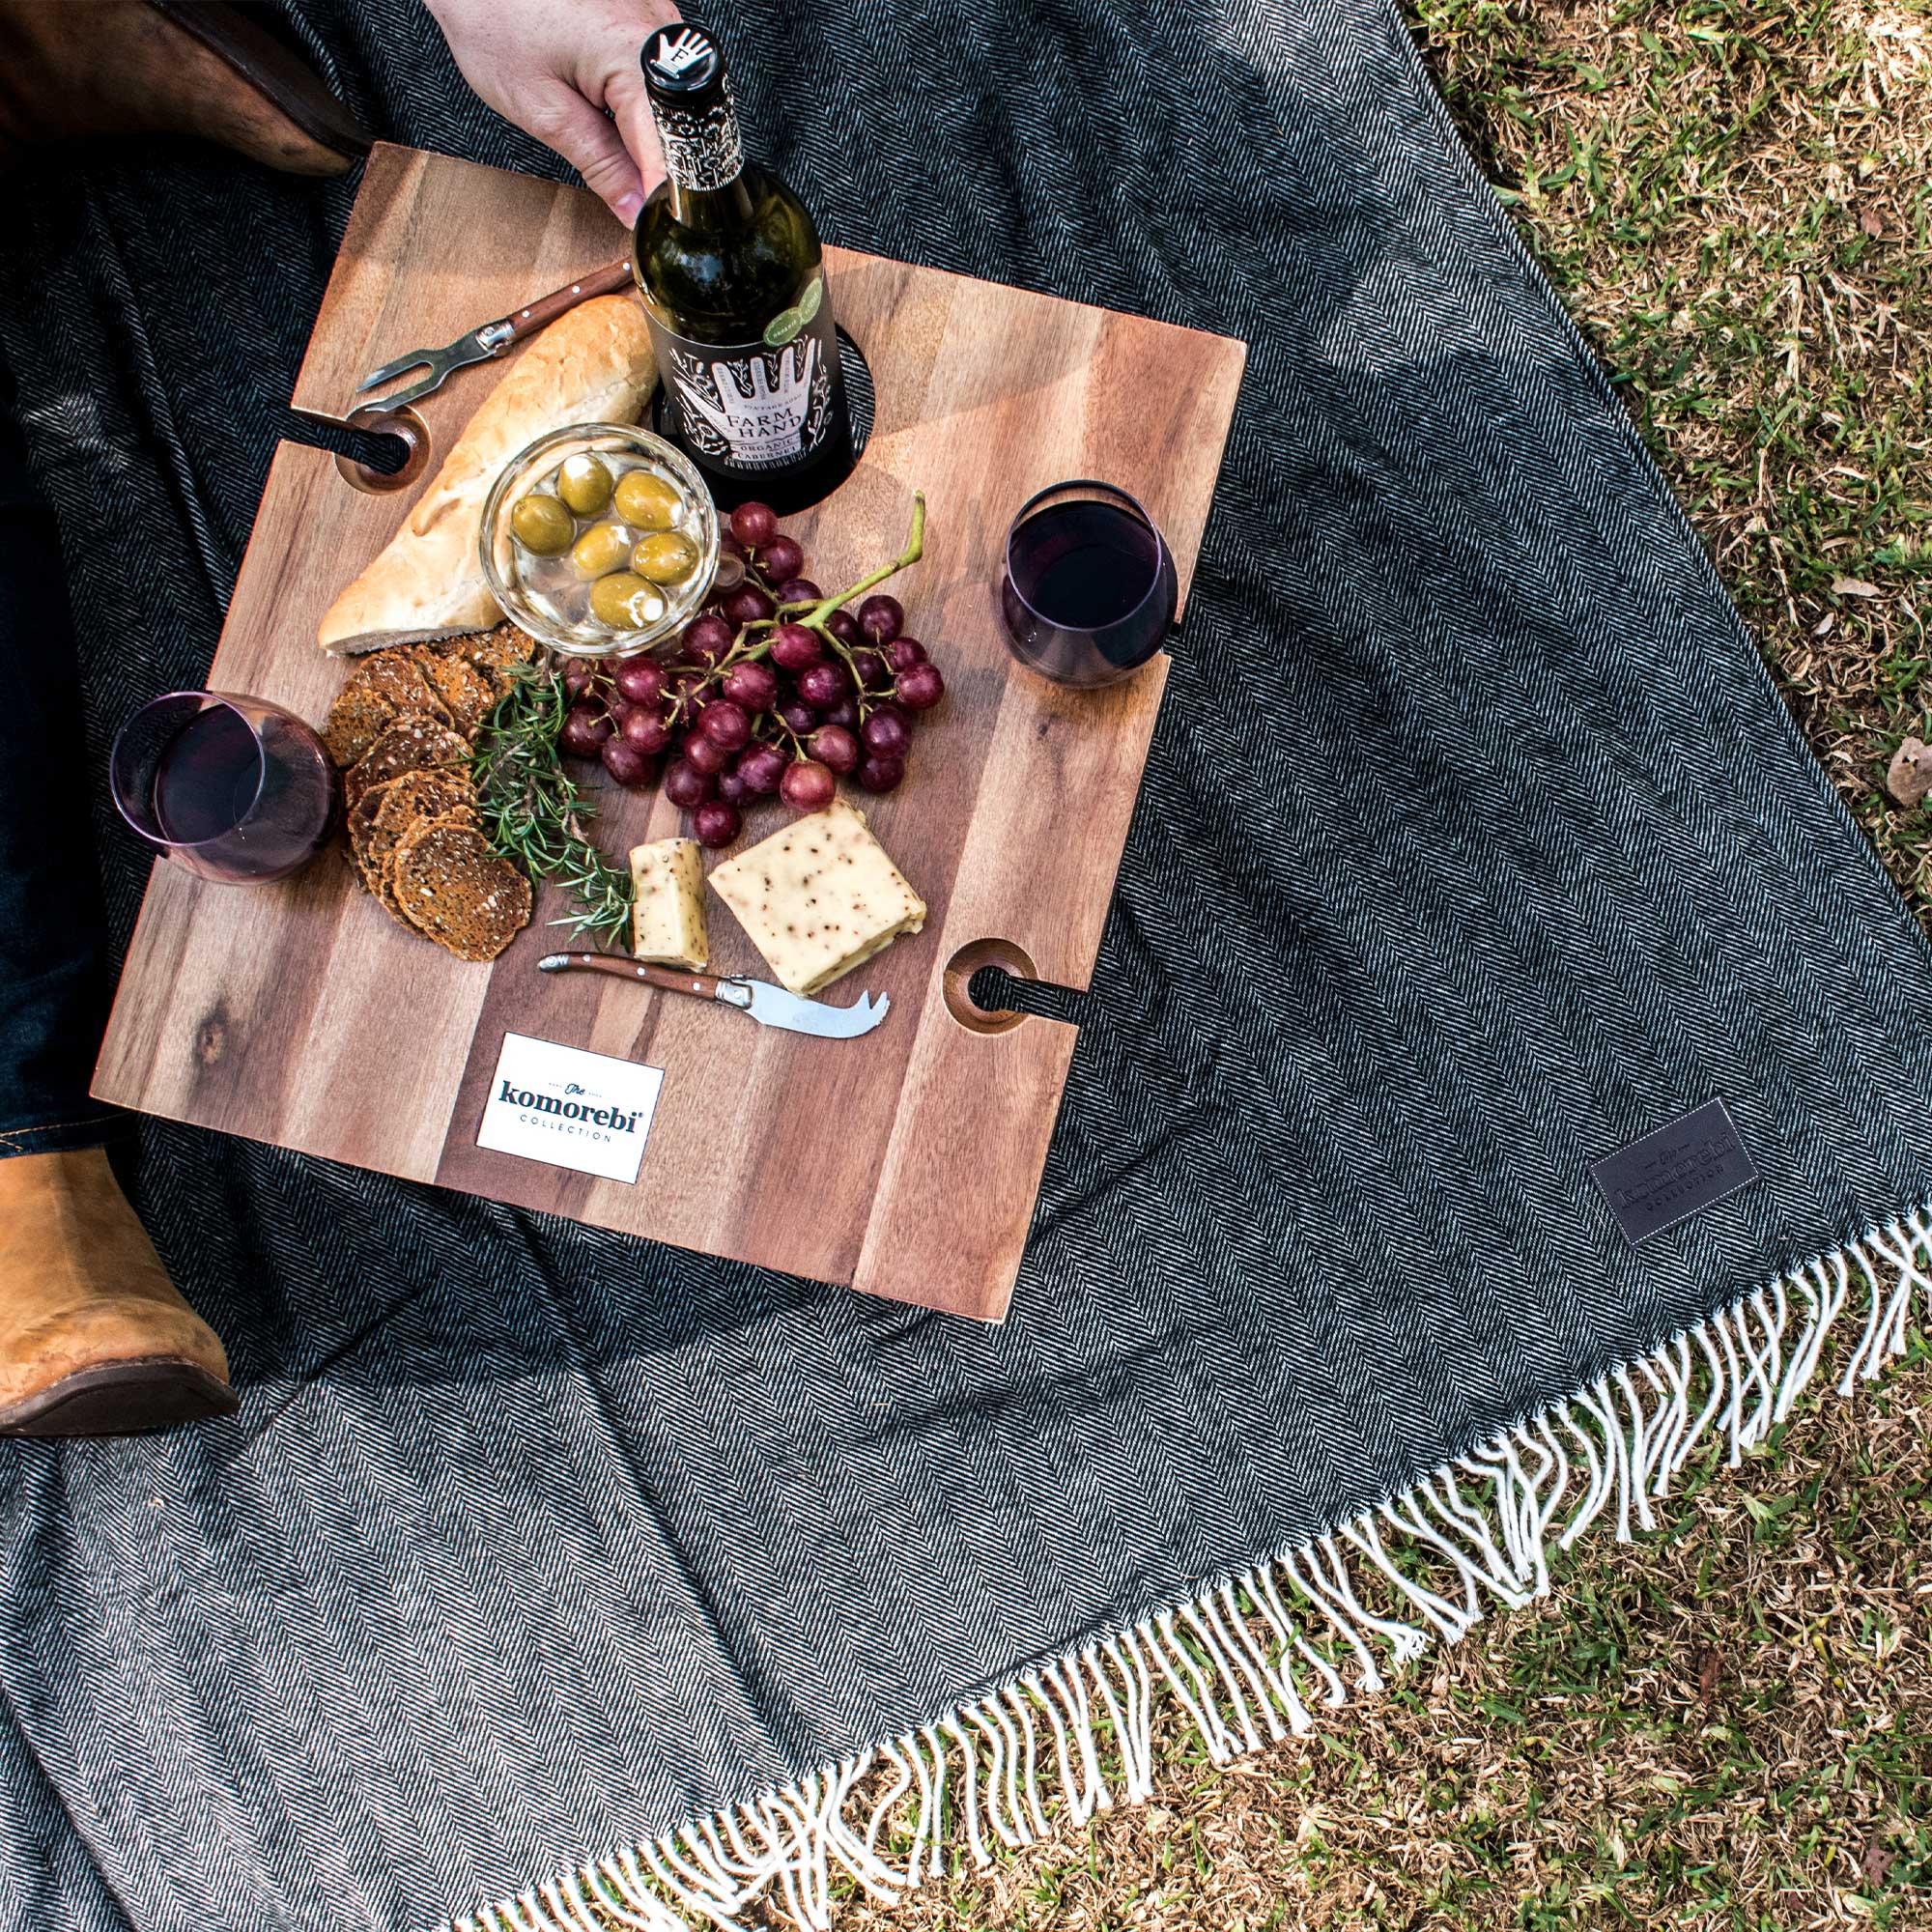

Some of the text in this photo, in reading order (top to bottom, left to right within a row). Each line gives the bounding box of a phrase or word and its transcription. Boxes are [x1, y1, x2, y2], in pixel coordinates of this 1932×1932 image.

[670, 47, 689, 62] F
[744, 402, 782, 411] VINTAGE
[726, 408, 794, 427] FARM
[739, 415, 802, 438] HAND
[737, 445, 798, 460] CABERNET
[740, 439, 793, 452] ORGANIC
[564, 1083, 585, 1095] The
[520, 1114, 611, 1143] COLLECTION
[1614, 1131, 1736, 1209] komorebi
[1646, 1165, 1724, 1210] COLLECTION
